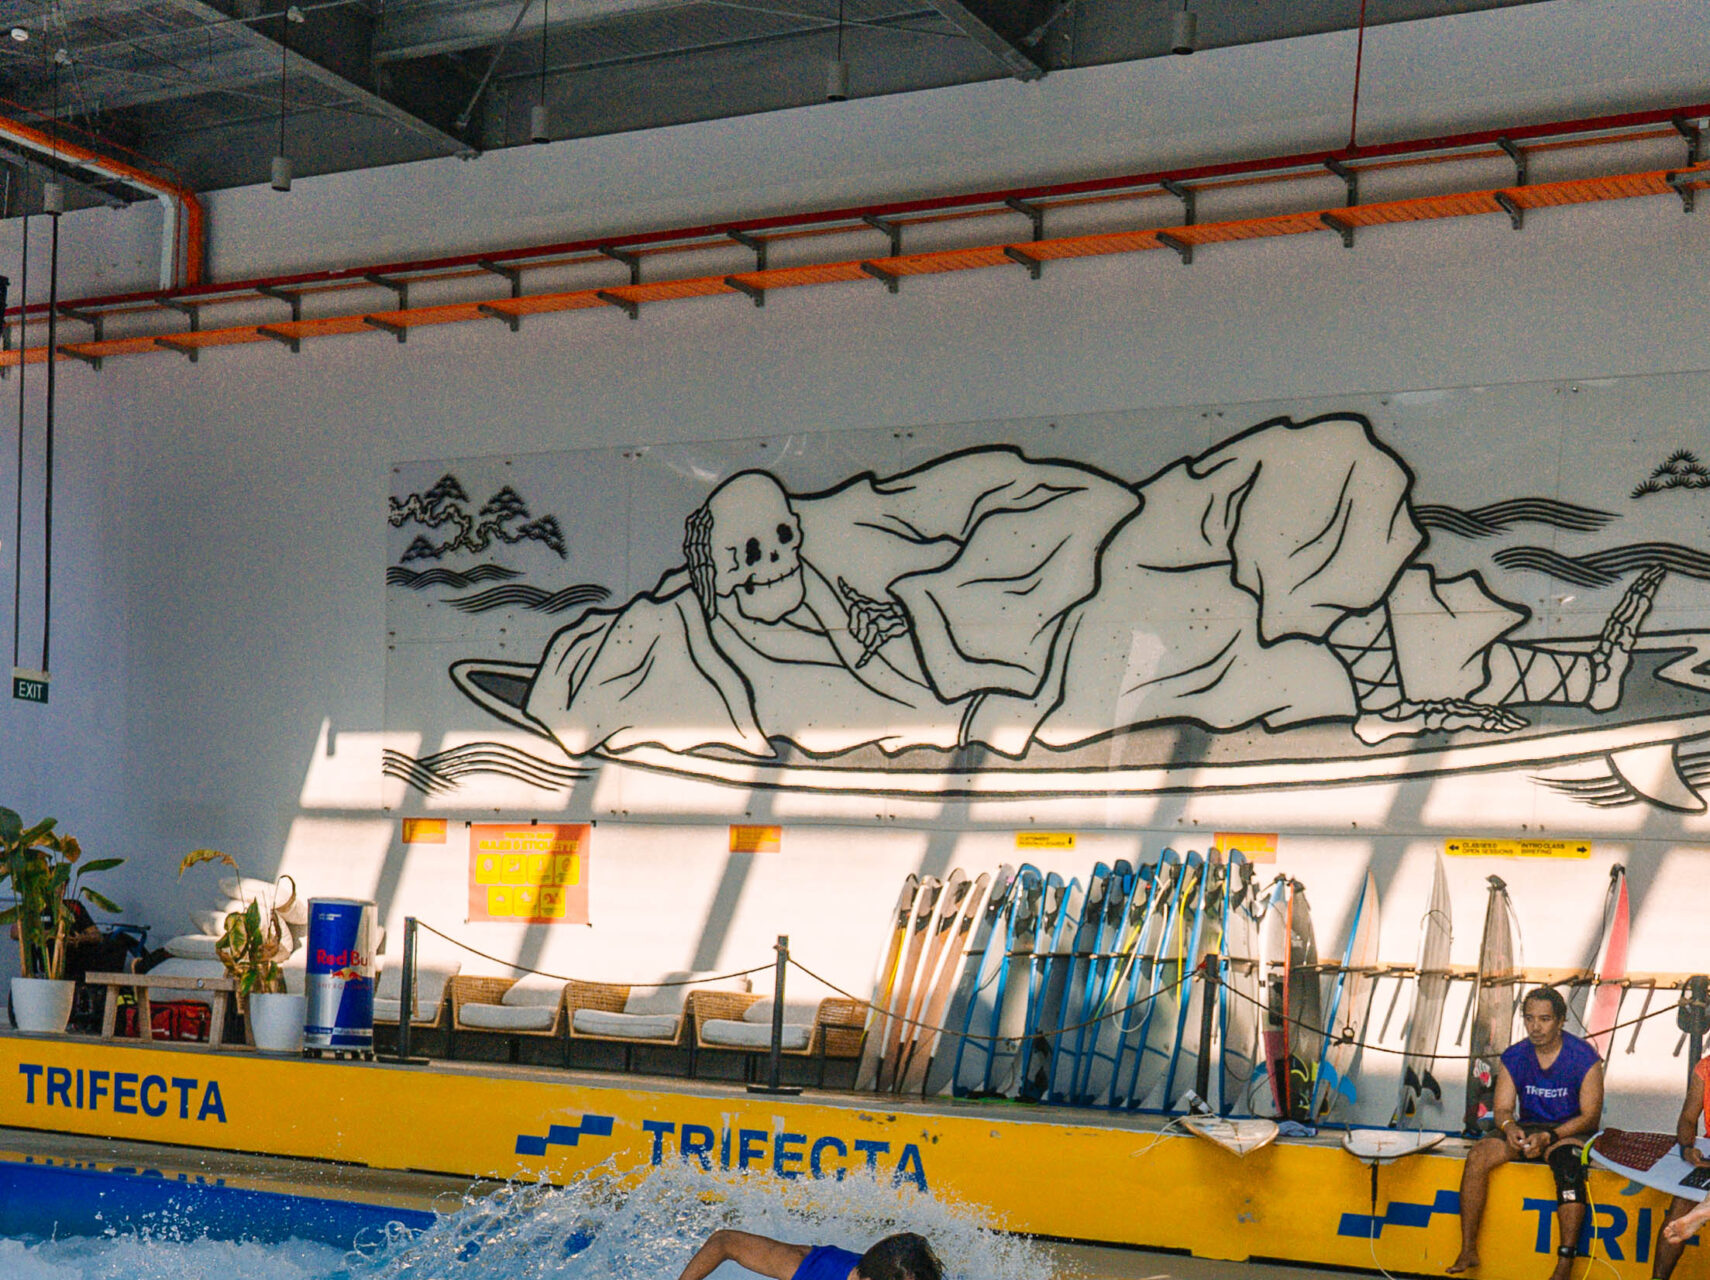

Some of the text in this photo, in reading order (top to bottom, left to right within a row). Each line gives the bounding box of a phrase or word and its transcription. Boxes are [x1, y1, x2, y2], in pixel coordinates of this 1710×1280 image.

[18, 681, 44, 699] EXIT
[316, 949, 374, 967] Red Bul
[19, 1063, 227, 1123] TRIFECTA
[642, 1119, 928, 1193] TRIFECTA
